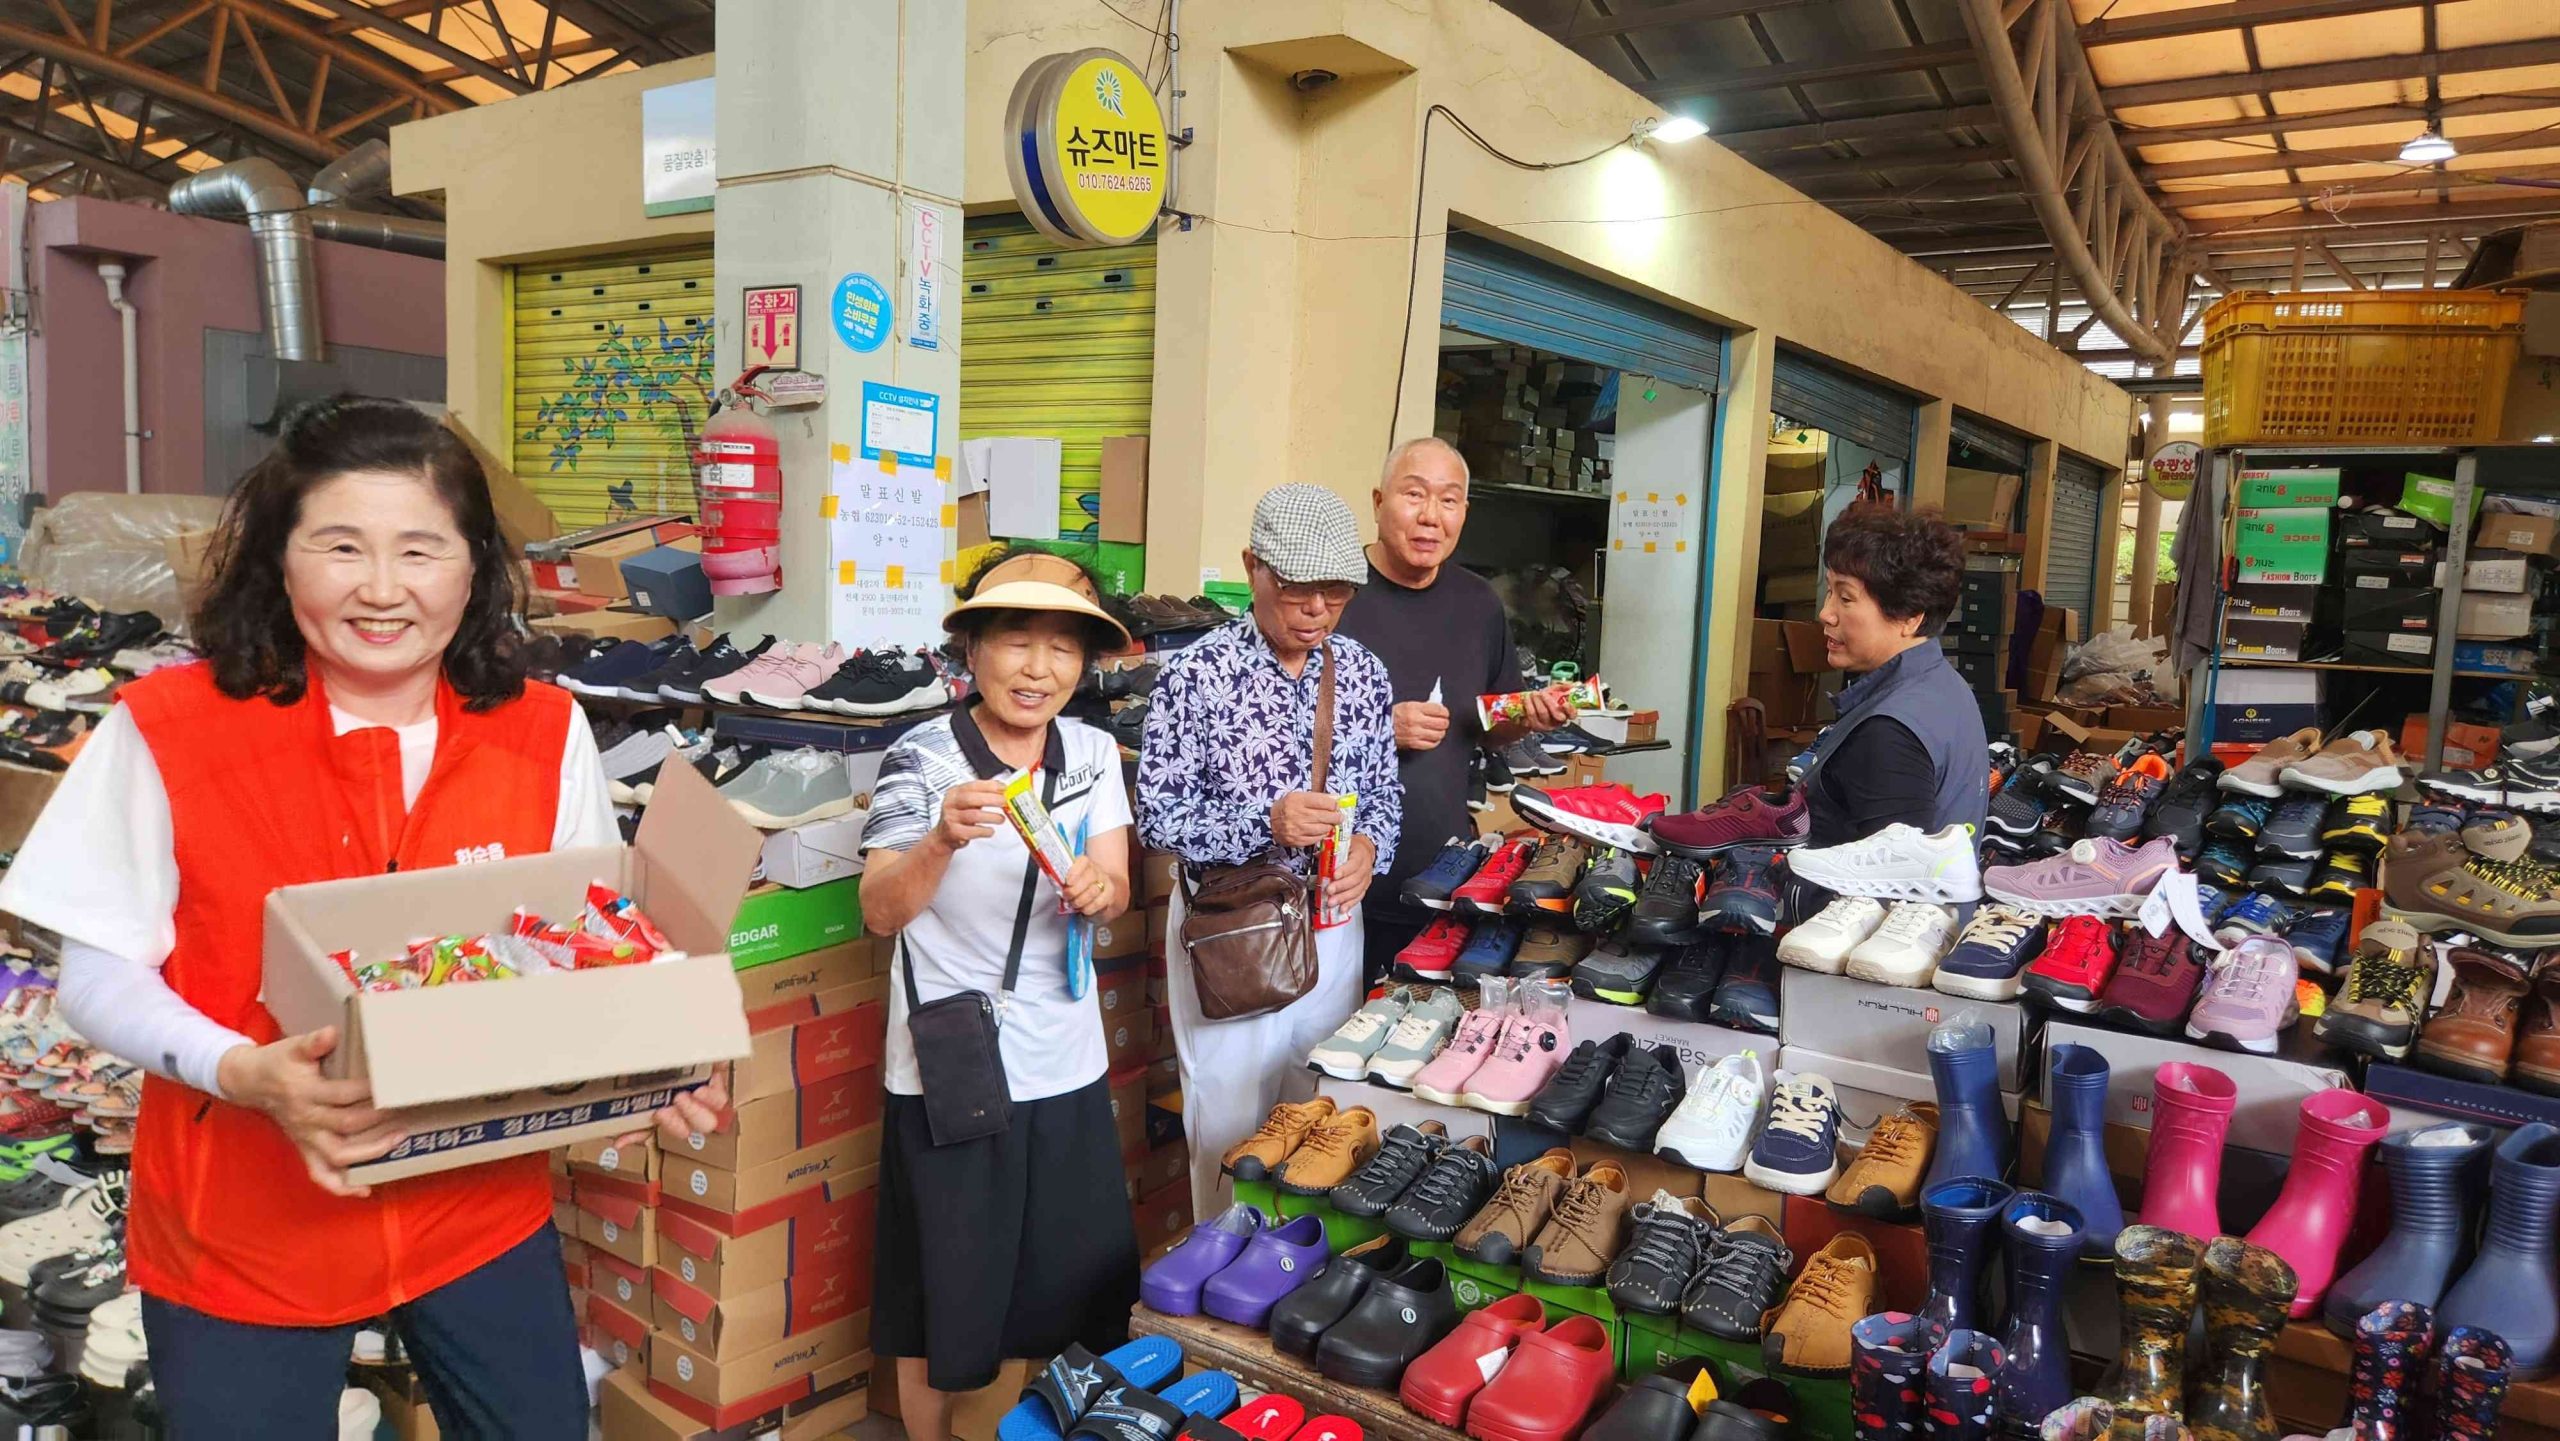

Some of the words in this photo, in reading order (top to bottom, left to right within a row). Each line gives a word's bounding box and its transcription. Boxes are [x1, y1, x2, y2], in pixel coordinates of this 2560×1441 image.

[1066, 126, 1159, 170] 슈즈마트
[1078, 173, 1152, 192] 010.7624.6265
[750, 293, 794, 309] 소화기
[879, 391, 898, 402] CCTV
[2153, 458, 2197, 472] 송광상
[1116, 570, 1126, 597] GAR
[1058, 764, 1094, 791] Court
[454, 842, 506, 866] 화순읍
[731, 924, 779, 947] EDGAR
[1656, 1033, 1690, 1047] MARKET
[2444, 1097, 2543, 1122] PERFORMANCE
